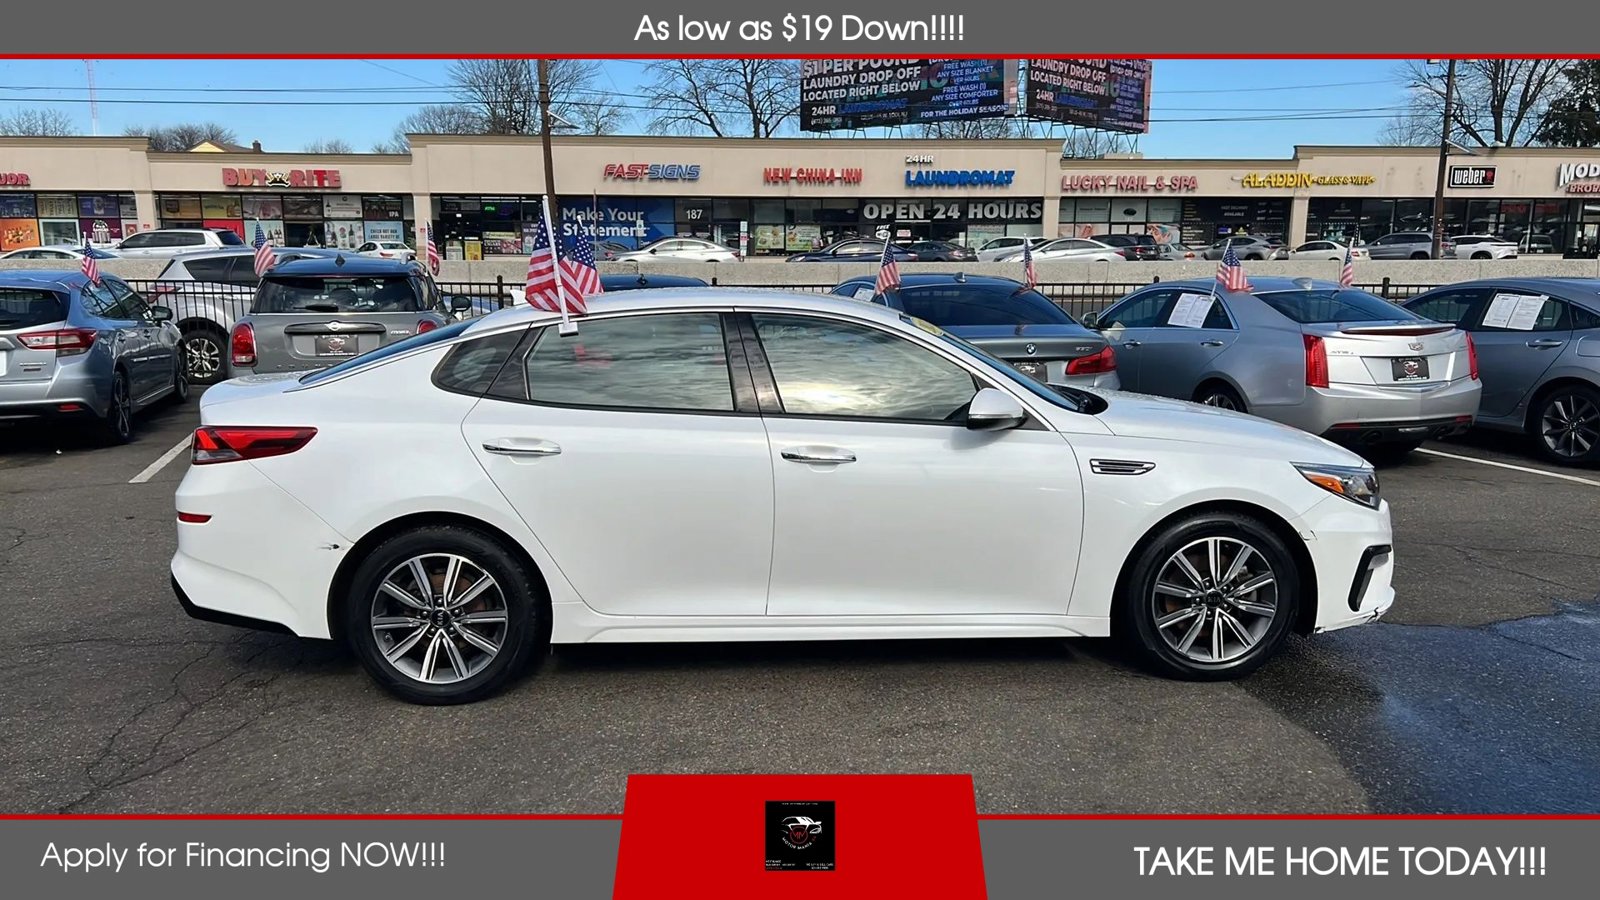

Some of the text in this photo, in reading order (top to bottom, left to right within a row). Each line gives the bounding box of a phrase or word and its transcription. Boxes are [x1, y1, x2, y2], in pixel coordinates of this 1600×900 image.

[803, 66, 921, 90] LAUNDRY DROP OFF
[965, 66, 994, 75] BLANKET
[1031, 59, 1070, 74] LAUNDRY
[1070, 64, 1091, 80] DROP
[1093, 69, 1107, 82] OFF
[959, 84, 978, 92] WASH
[1030, 71, 1062, 85] LOCATED
[1063, 78, 1082, 91] RIGHT
[1083, 82, 1106, 95] BELOW
[803, 81, 920, 101] LOCATED RIGHT BELOW
[931, 94, 944, 102] ANY
[959, 89, 998, 98] COMFORTER
[1036, 89, 1054, 102] 24HR
[811, 105, 836, 116] 24HR
[949, 108, 977, 116] HOLIDAY
[222, 167, 342, 187] BUY RITE
[603, 164, 700, 179] FASTSIGNS
[764, 168, 863, 183] NEW CHINA INN
[905, 169, 1014, 187] LAUNDROMAT
[1454, 167, 1485, 184] weber
[1559, 163, 1600, 187] MOD
[1062, 175, 1198, 190] LUCKY NAIL & SPA
[1242, 172, 1370, 187] ALADDIN GLASS & VAPE
[562, 207, 644, 221] Make Your
[687, 209, 702, 220] 187
[863, 203, 1042, 219] OPEN 24 HOURS
[563, 223, 647, 237] Statemen
